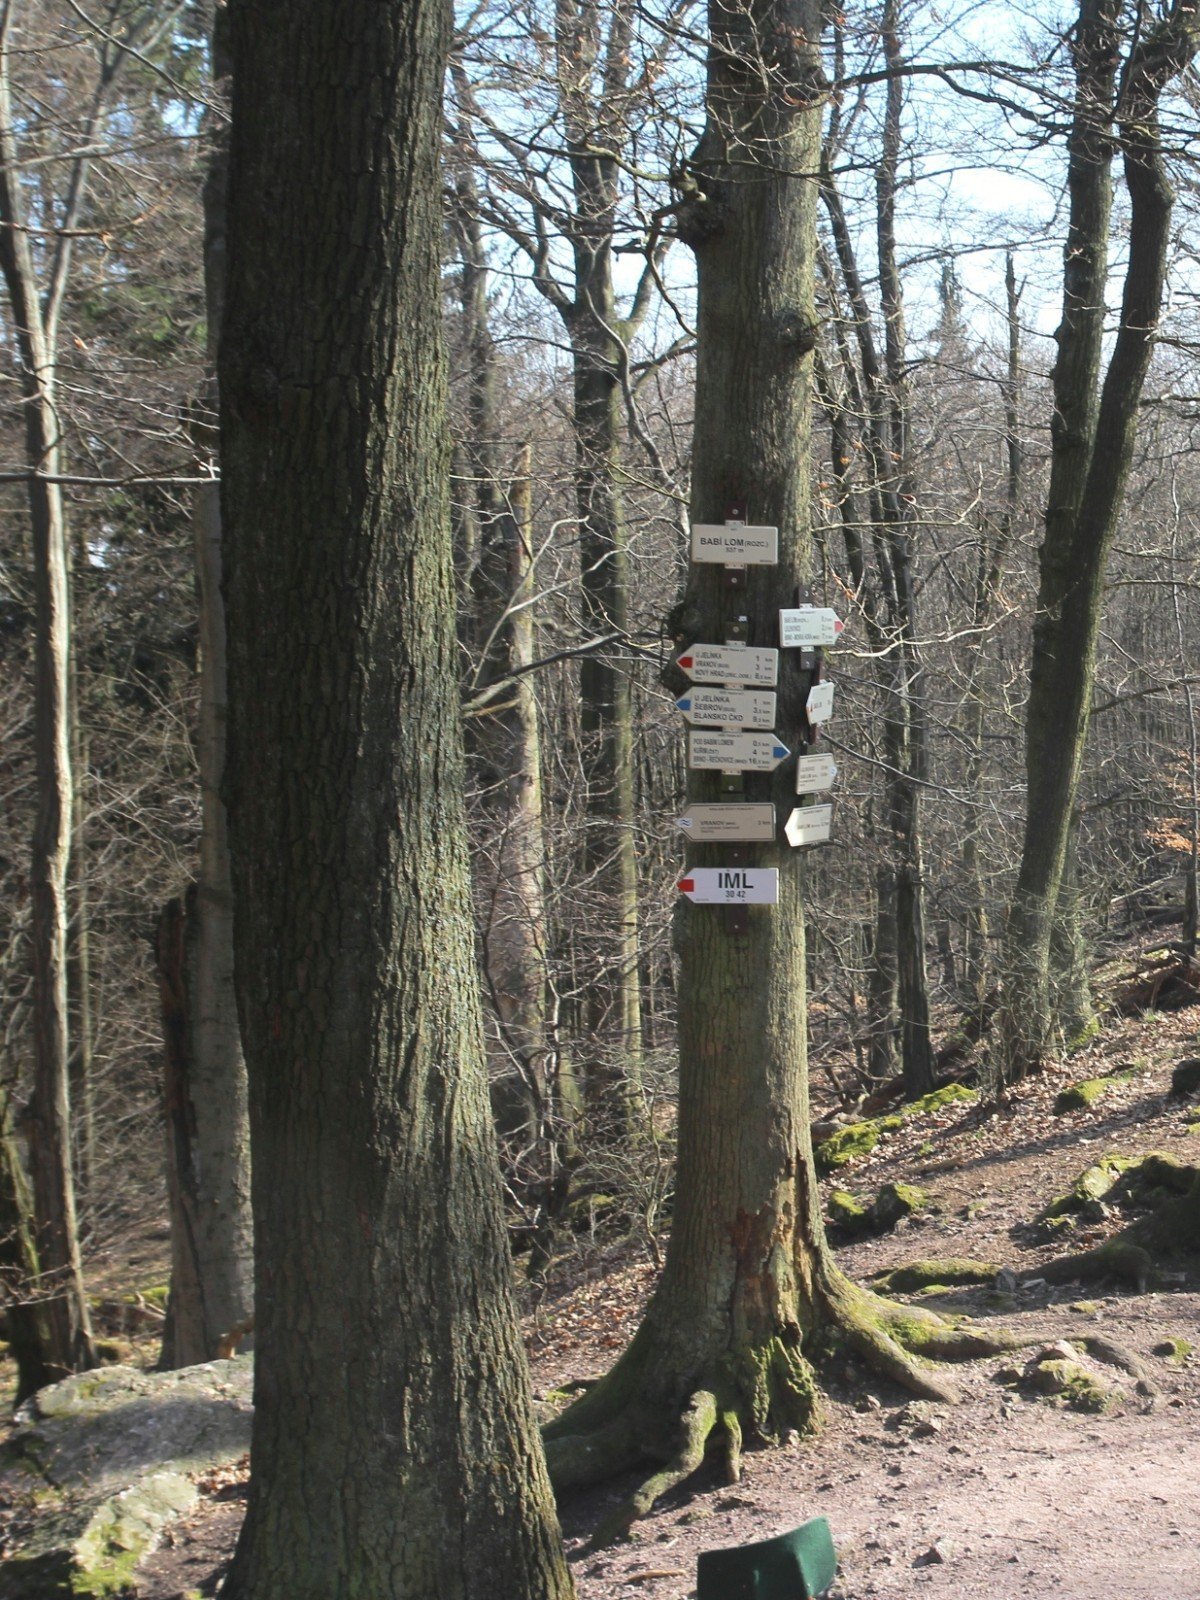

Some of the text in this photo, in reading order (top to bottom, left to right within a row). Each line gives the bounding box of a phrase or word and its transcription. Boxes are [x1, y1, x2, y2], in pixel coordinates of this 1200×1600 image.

[700, 536, 769, 548] BABÍ LOM (ROZC.)
[700, 652, 722, 660] JELÍNKA
[701, 695, 730, 703] JELÍNKA
[694, 702, 722, 711] ŠEBROV
[694, 711, 744, 722] BLANSKO ČKD
[718, 872, 754, 889] IML
[736, 890, 746, 898] 42
